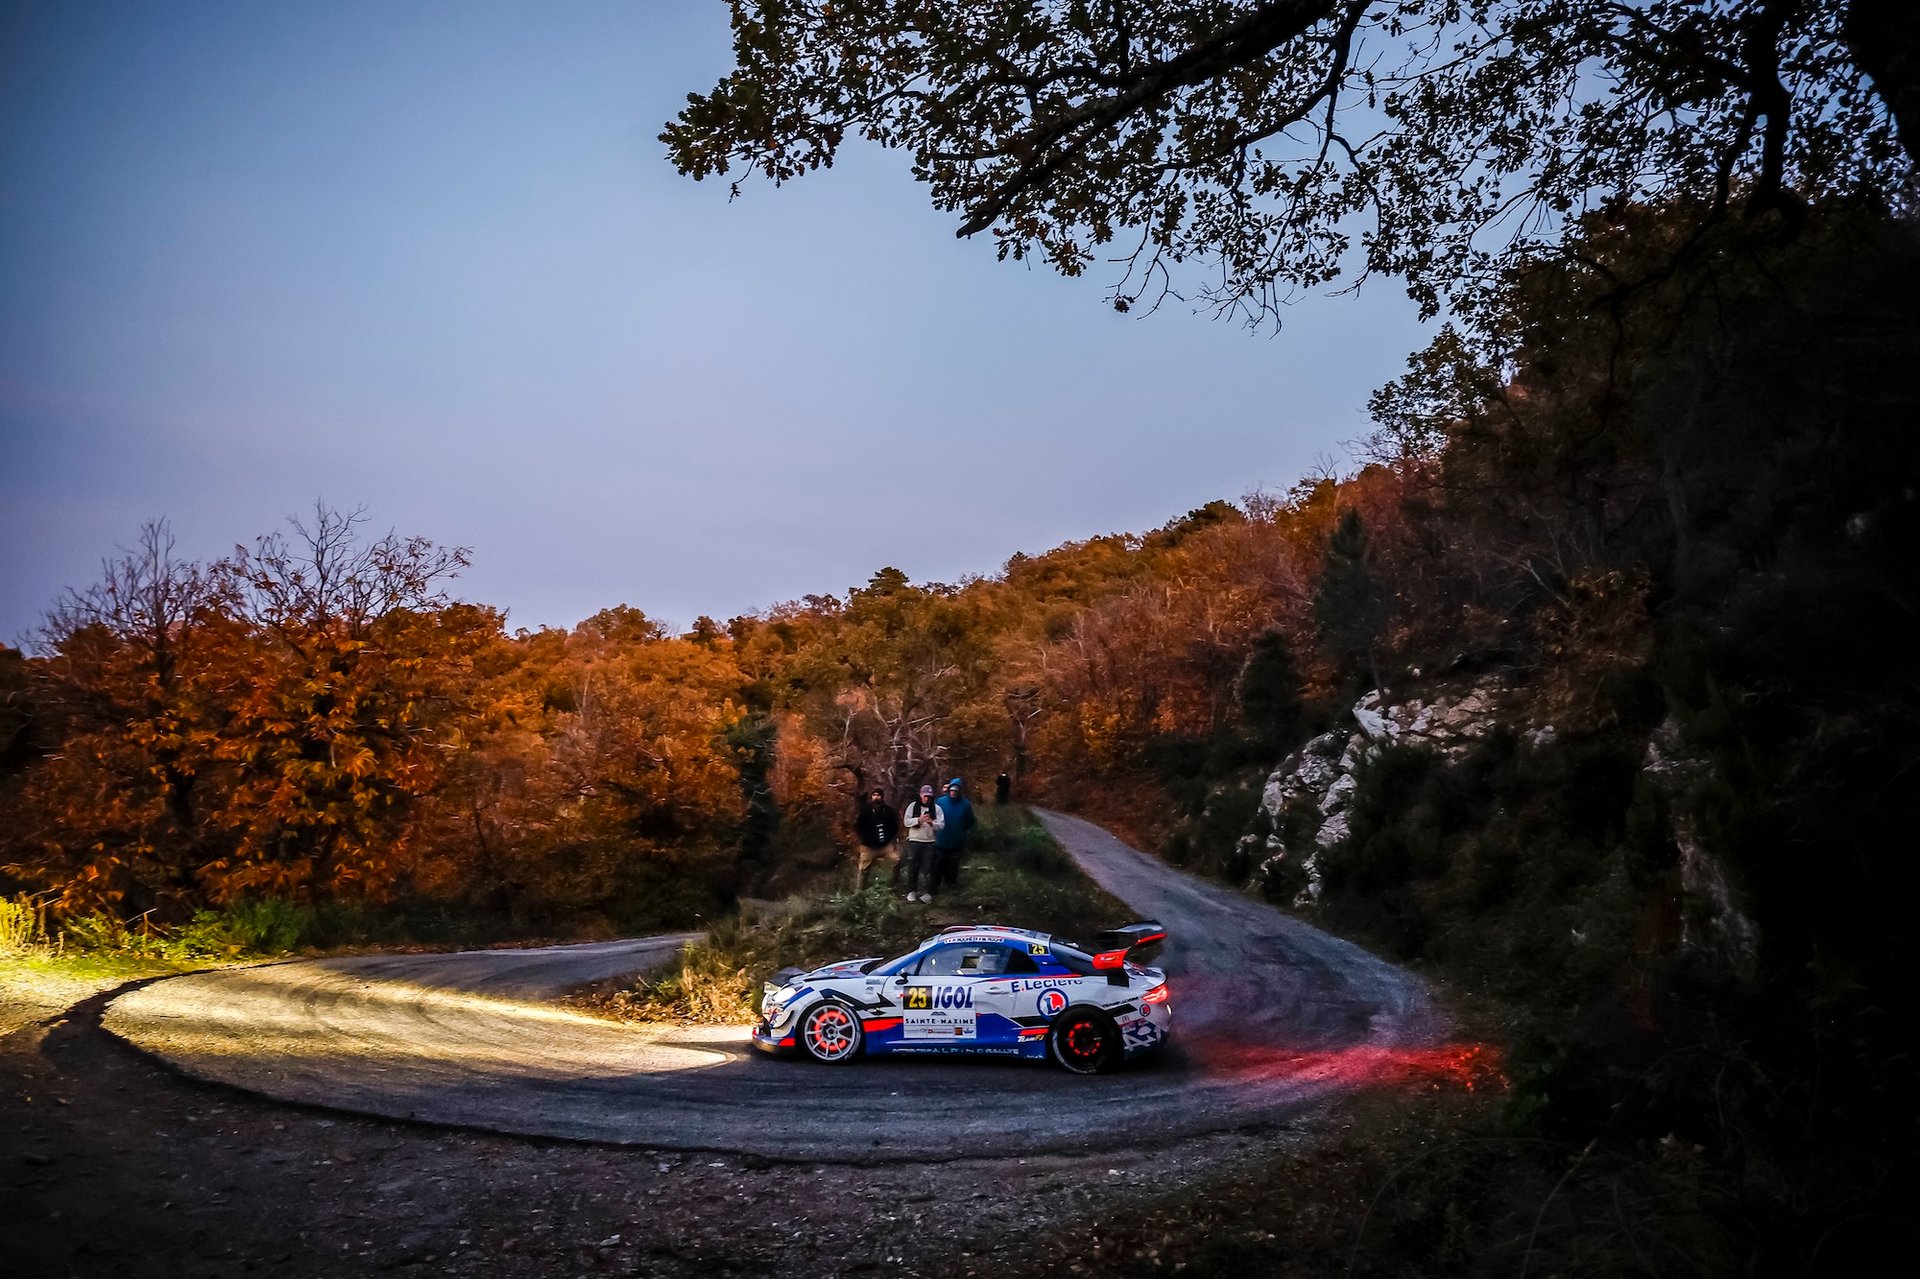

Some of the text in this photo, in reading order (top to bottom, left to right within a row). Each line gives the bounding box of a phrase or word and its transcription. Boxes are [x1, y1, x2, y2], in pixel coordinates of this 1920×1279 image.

[1032, 944, 1045, 954] 25
[908, 987, 927, 1008] 25
[933, 986, 974, 1008] IGOL
